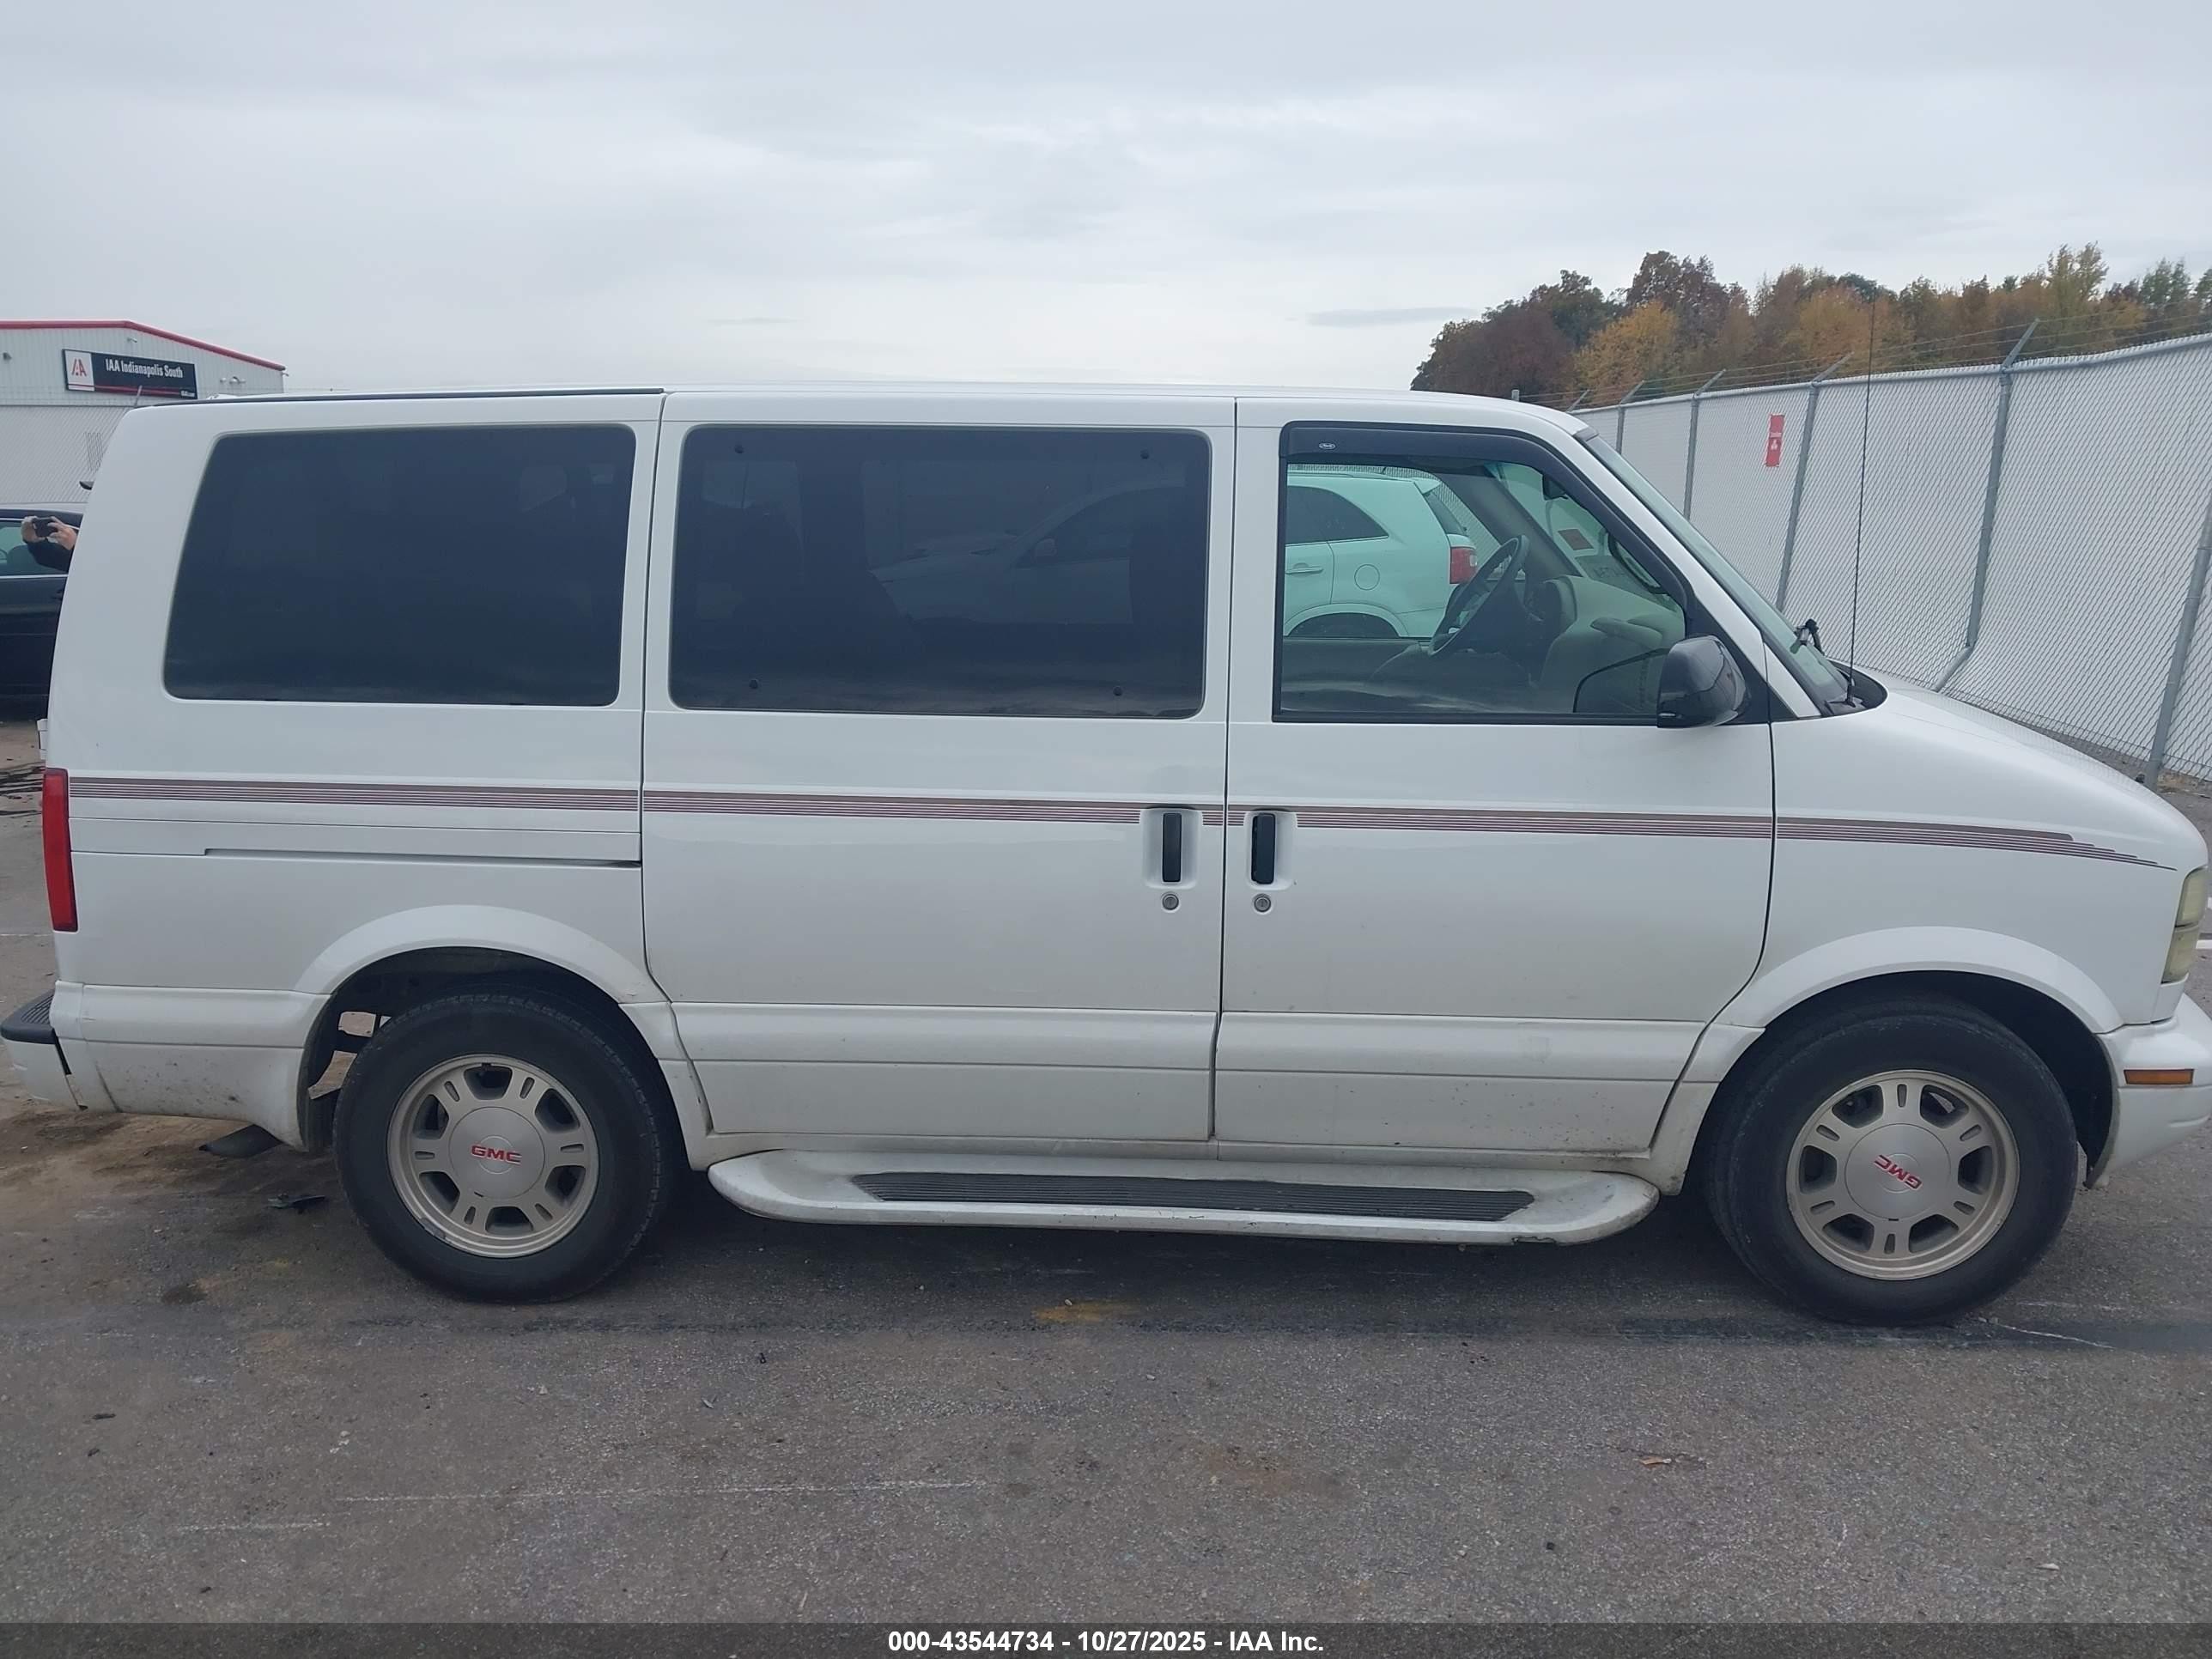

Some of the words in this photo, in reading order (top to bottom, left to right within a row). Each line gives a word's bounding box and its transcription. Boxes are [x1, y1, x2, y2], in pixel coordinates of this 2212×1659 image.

[106, 358, 120, 372] IAA
[121, 361, 163, 378] Indianapolis
[164, 365, 184, 378] South
[471, 1145, 522, 1164] GMC
[1874, 1154, 1923, 1190] GMC
